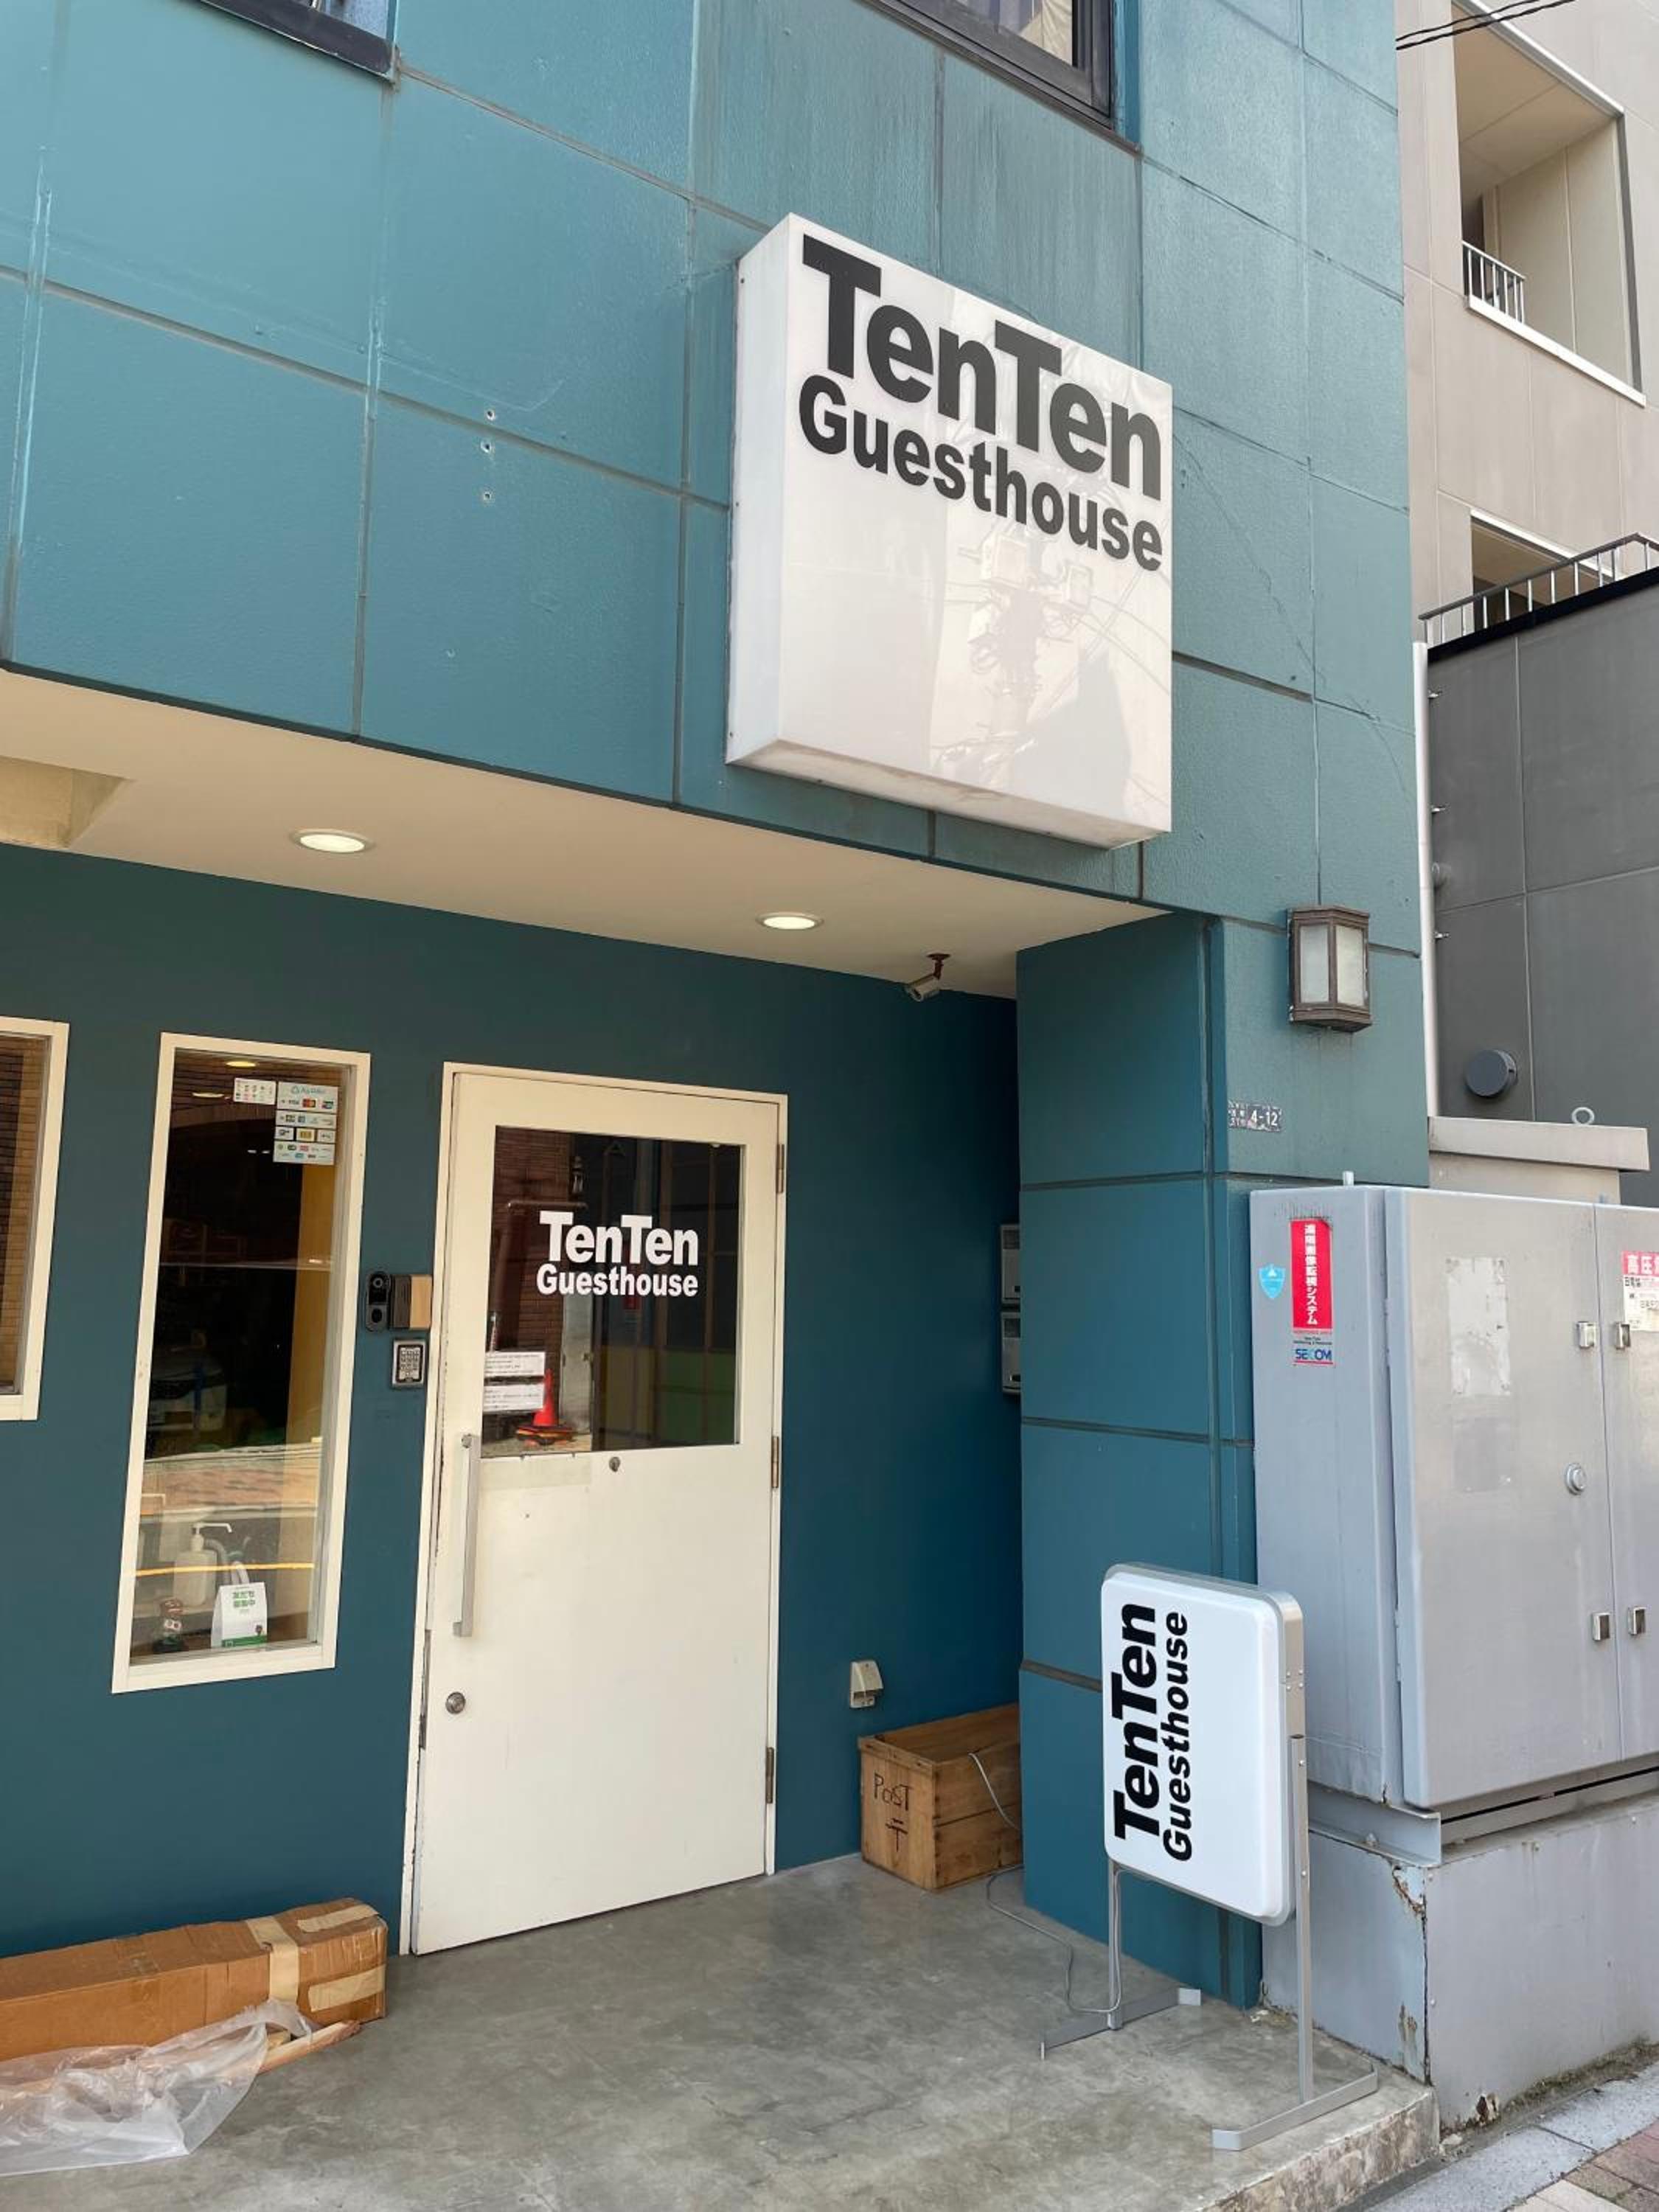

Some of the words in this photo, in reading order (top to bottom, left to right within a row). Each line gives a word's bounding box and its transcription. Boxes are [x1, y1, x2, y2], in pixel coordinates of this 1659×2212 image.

[803, 233, 1161, 501] TenTen
[799, 374, 1163, 571] Guesthouse
[1251, 1110, 1279, 1127] 4-12
[536, 1263, 699, 1297] Guesthouse
[539, 1210, 699, 1266] TenTen
[1111, 1603, 1161, 1840] TenTen
[1161, 1612, 1193, 1862] Guesthouse
